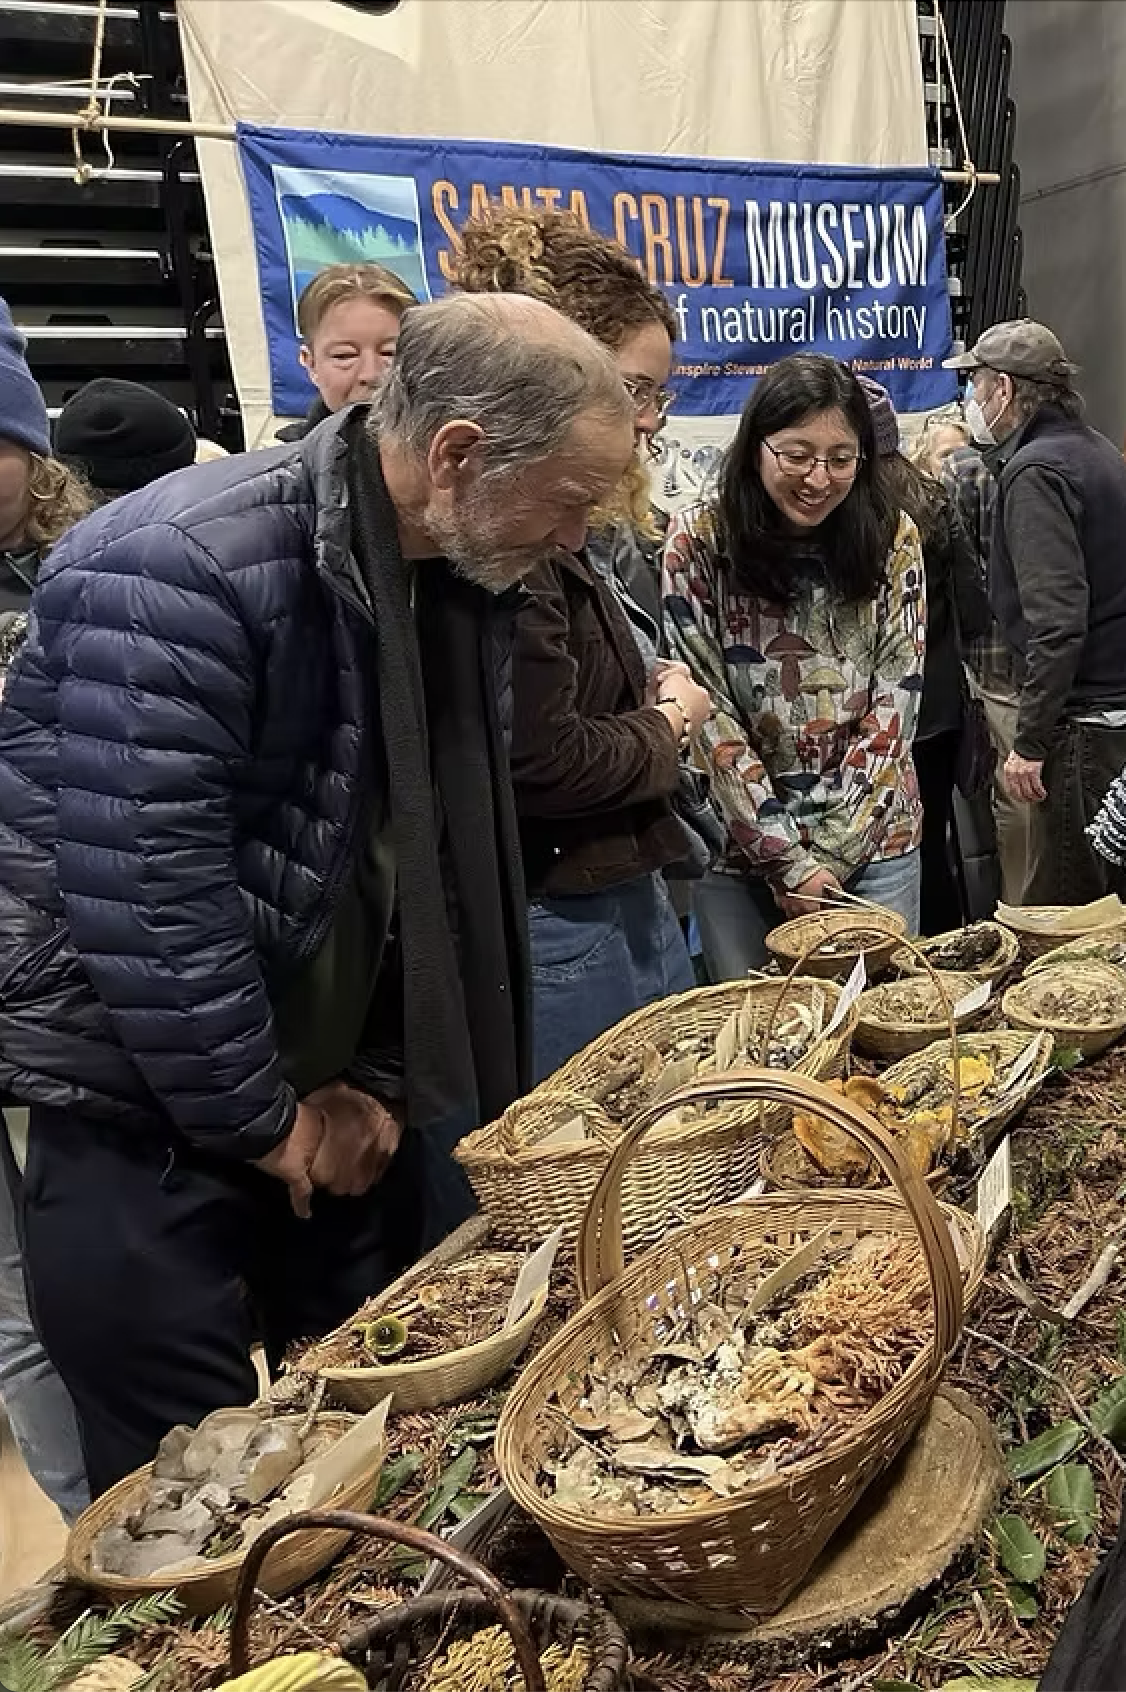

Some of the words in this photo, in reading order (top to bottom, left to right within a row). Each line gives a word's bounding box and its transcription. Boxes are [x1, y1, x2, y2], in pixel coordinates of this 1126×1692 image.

[613, 191, 735, 289] CRUZ
[745, 200, 927, 289] MUSEUM
[675, 293, 689, 342] f
[701, 296, 815, 343] natural
[826, 296, 927, 349] history
[853, 358, 895, 372] Natural
[897, 356, 934, 371] World
